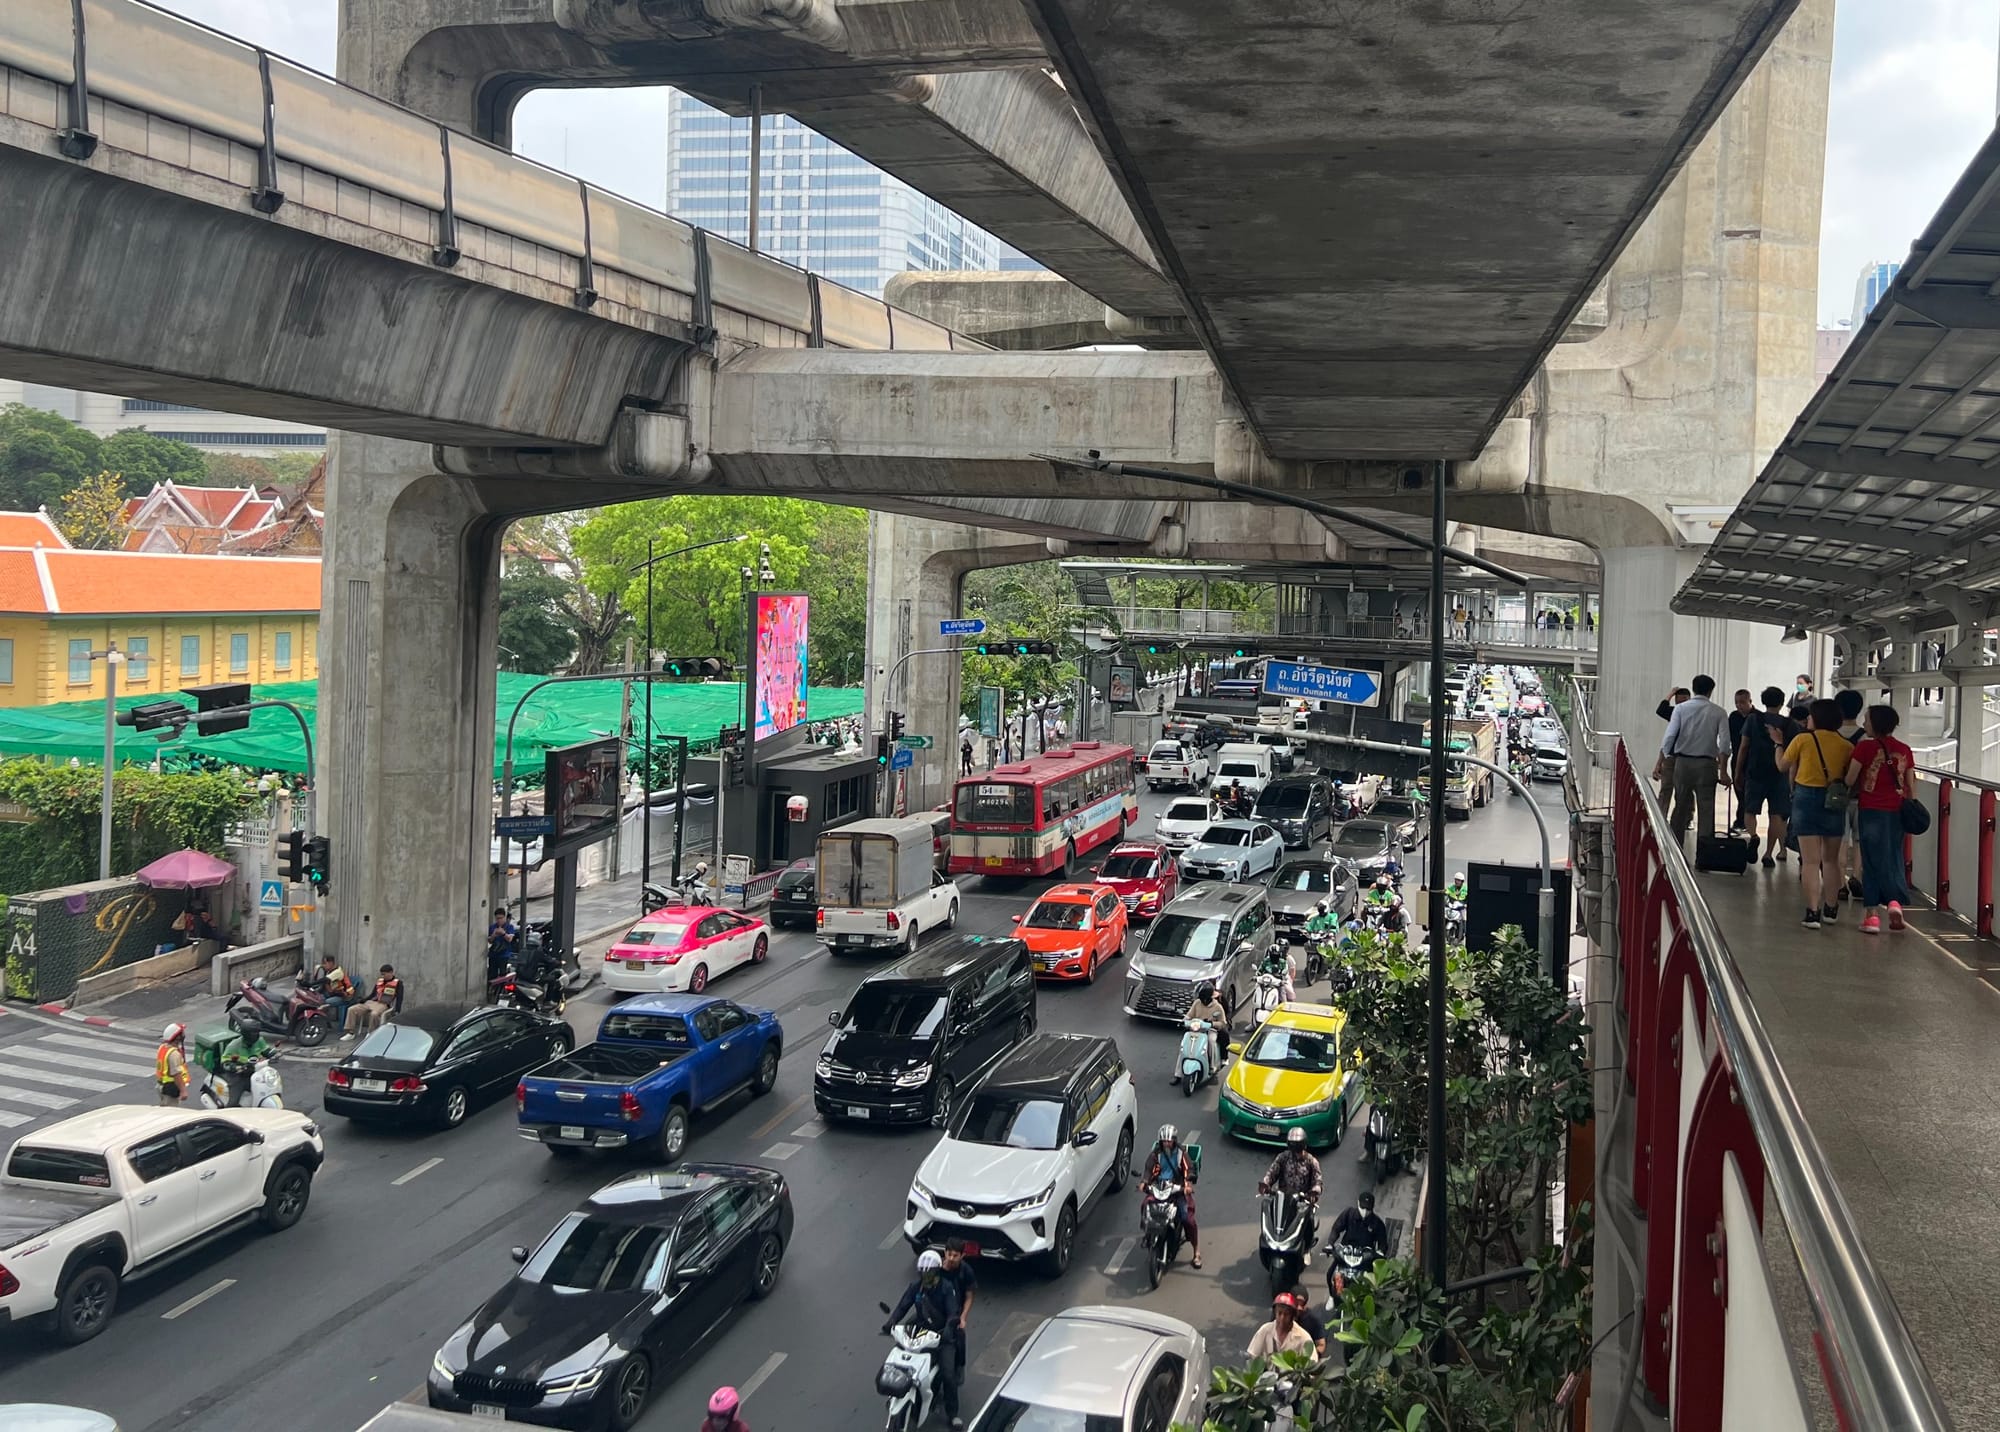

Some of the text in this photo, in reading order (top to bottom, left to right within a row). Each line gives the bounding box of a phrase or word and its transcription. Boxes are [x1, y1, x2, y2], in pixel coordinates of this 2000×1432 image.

[1278, 684, 1300, 694] Henri
[1303, 687, 1332, 698] Dunant
[6, 931, 38, 957] A4
